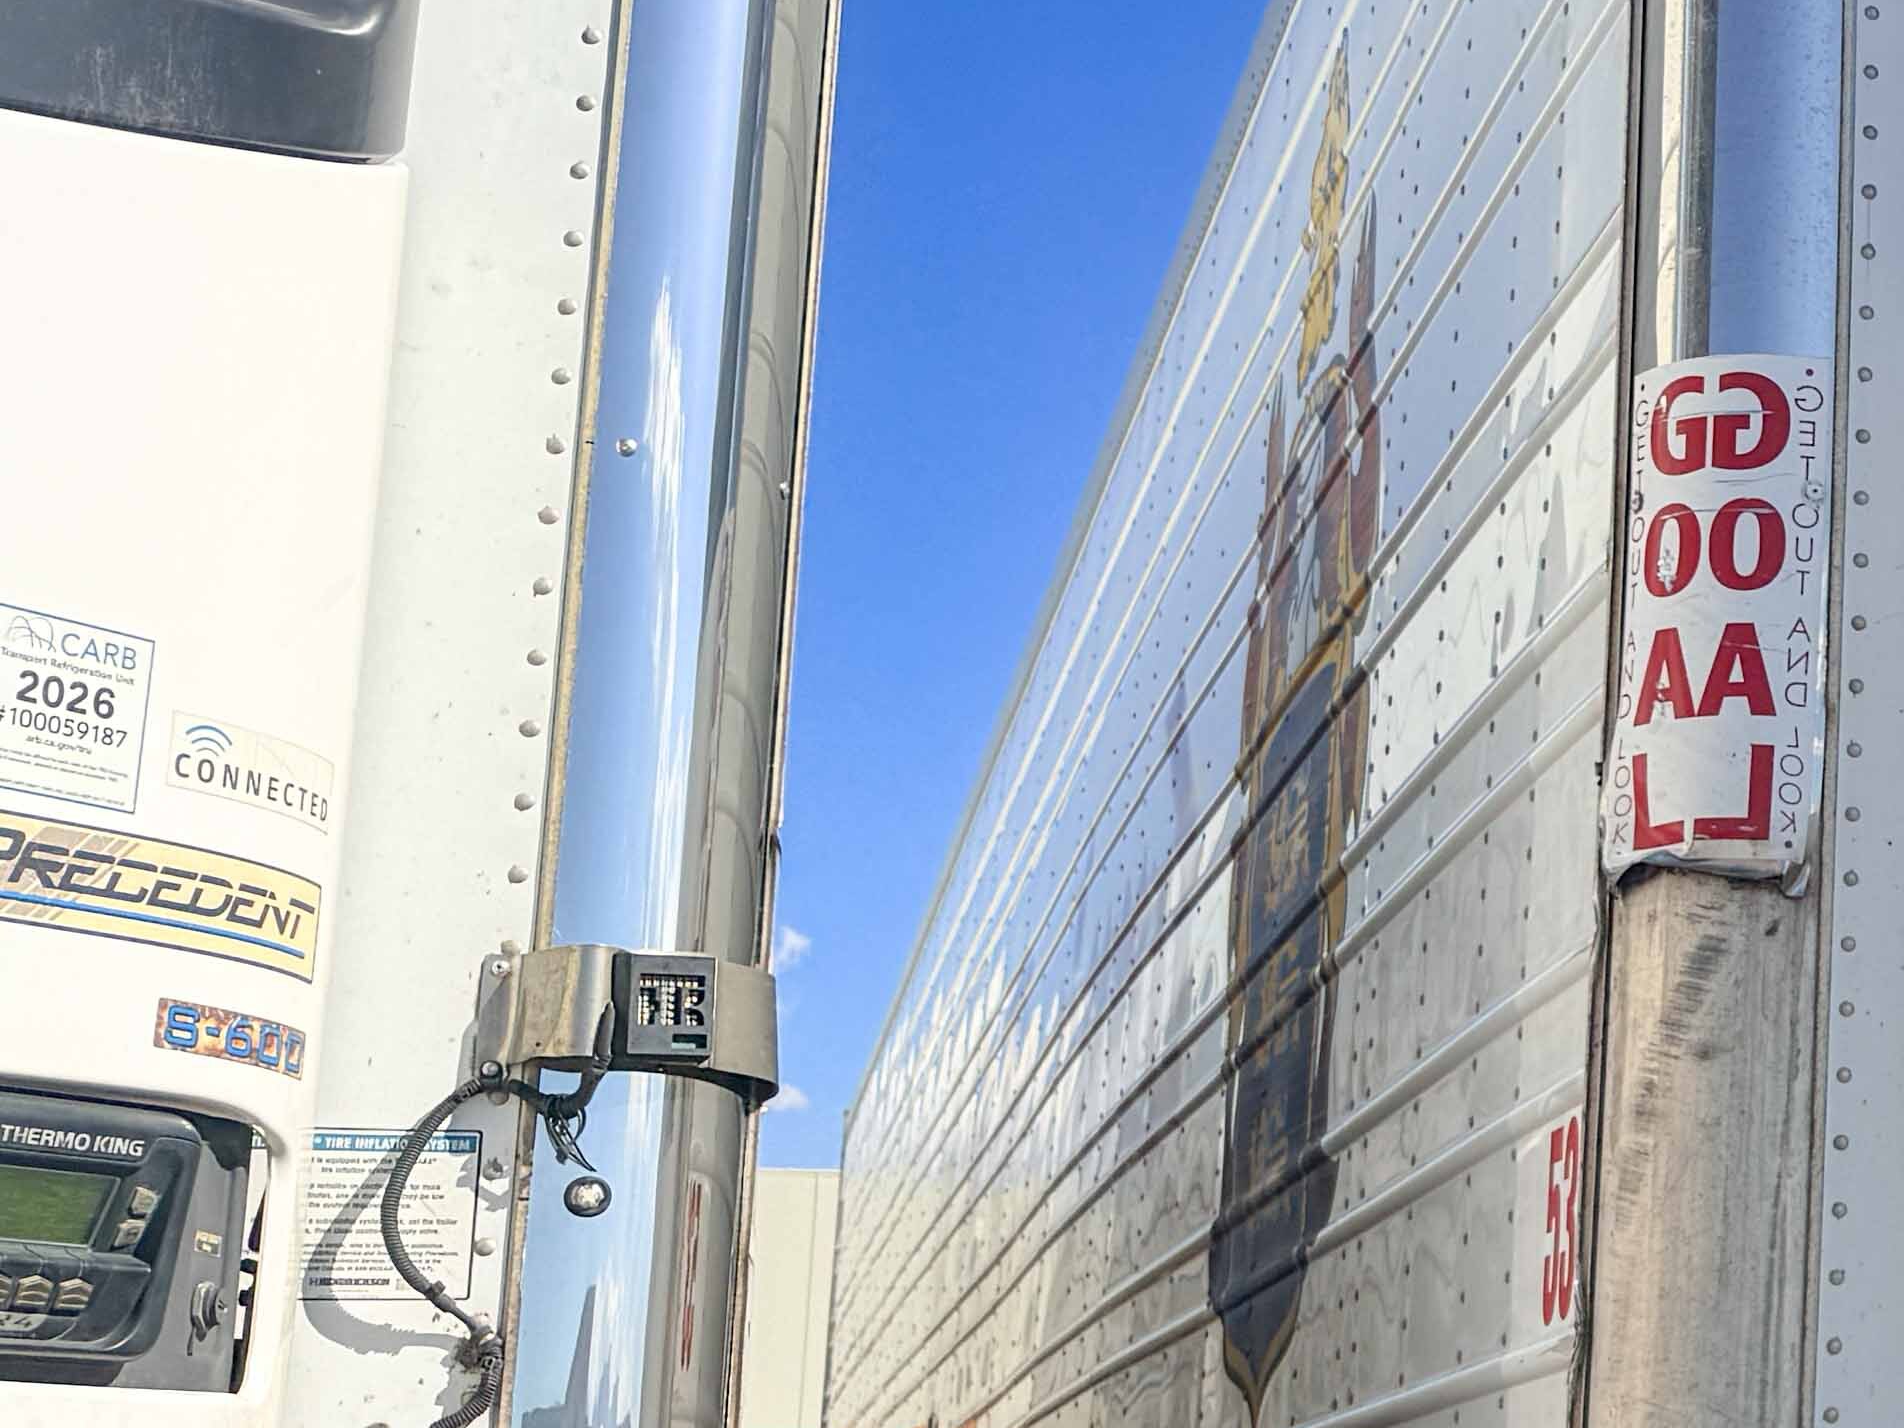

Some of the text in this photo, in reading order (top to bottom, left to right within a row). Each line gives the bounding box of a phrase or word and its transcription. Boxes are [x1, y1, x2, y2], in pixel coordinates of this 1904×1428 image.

[1630, 516, 1645, 612] OUT
[1632, 375, 1708, 851] GOAL
[0, 646, 135, 686] Transport Refrigeration Unit
[61, 633, 137, 670] CARB
[15, 669, 116, 719] 2026
[174, 753, 328, 822] CONNECTED
[1612, 738, 1633, 845] LOOK
[163, 1004, 302, 1074] S-600
[1, 1124, 145, 1157] THERMO KING
[325, 1137, 352, 1149] TIRE
[355, 1138, 410, 1150] INFLATIO
